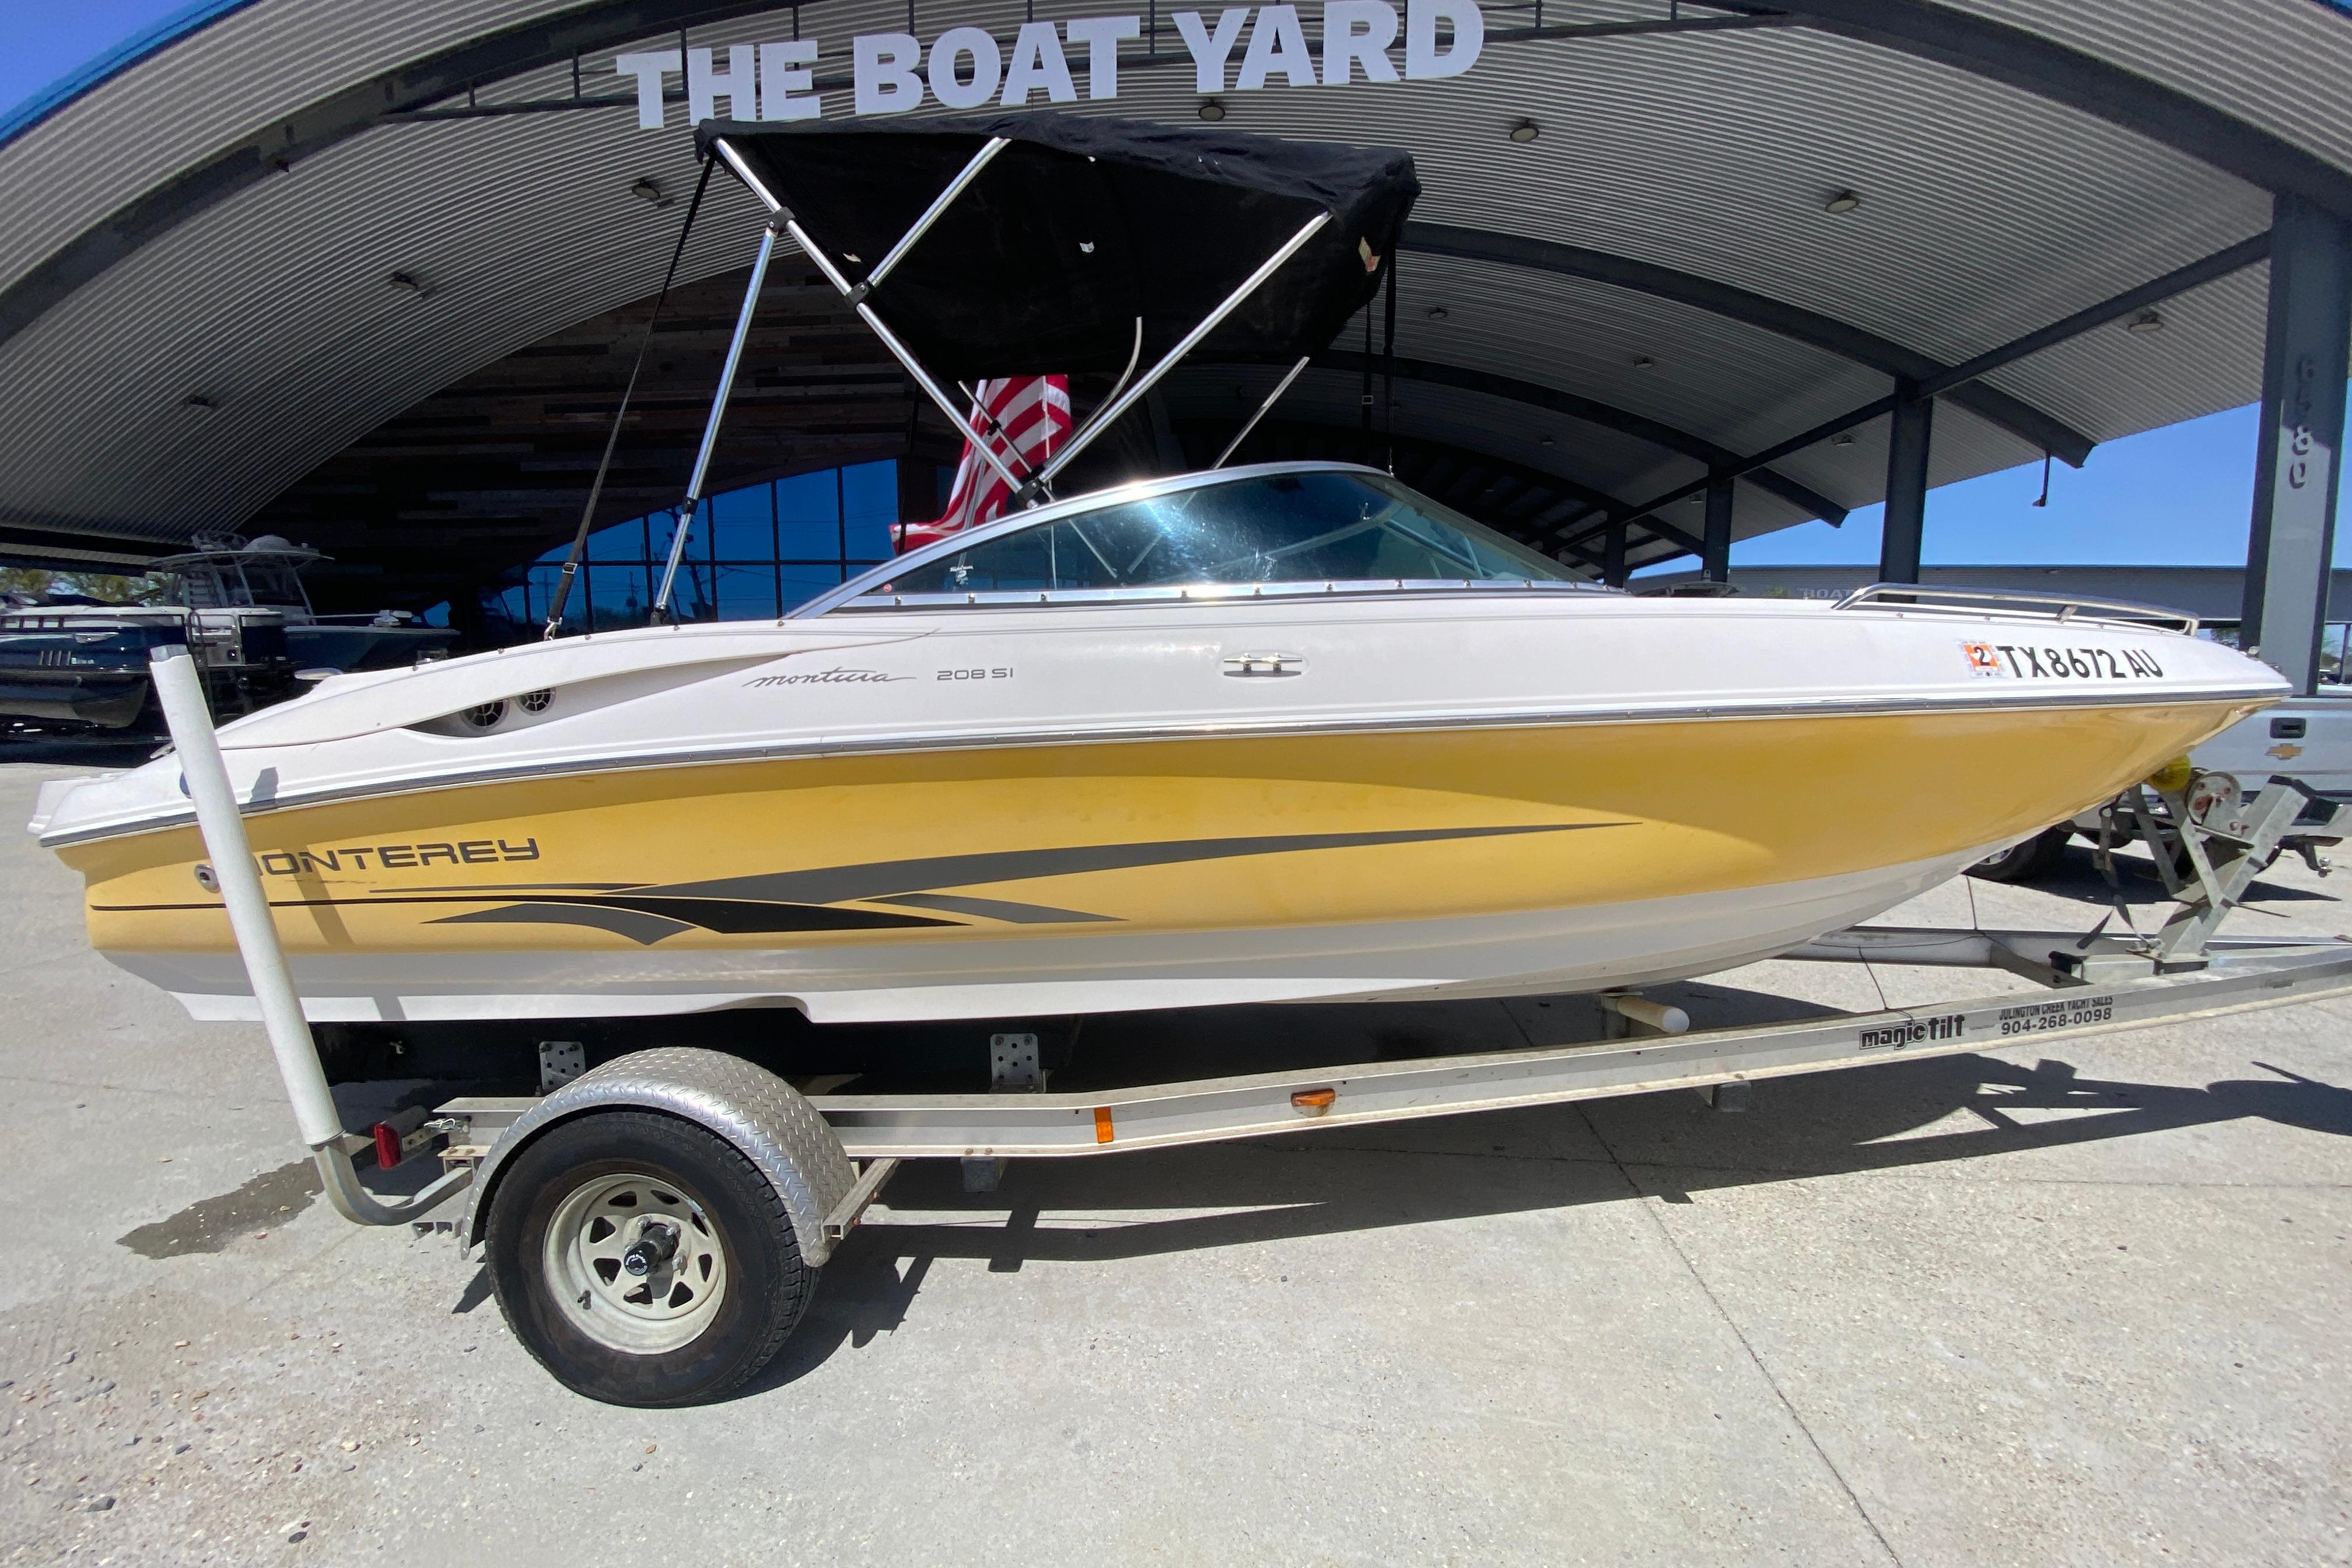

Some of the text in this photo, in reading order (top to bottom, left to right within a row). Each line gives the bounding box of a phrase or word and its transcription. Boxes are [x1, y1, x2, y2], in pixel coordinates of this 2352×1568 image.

[616, 0, 1484, 129] THE BOAT YARD
[1973, 646, 1991, 666] 2
[2121, 649, 2164, 678] AU
[741, 666, 917, 688] montura
[937, 668, 1013, 681] 208 SI
[254, 838, 540, 876] ONTEREY
[1999, 1005, 2041, 1021] JULINGTON
[2042, 1001, 2065, 1014] CREEK
[2091, 995, 2113, 1007] SALES
[2001, 1007, 2112, 1035] 904-268-0098
